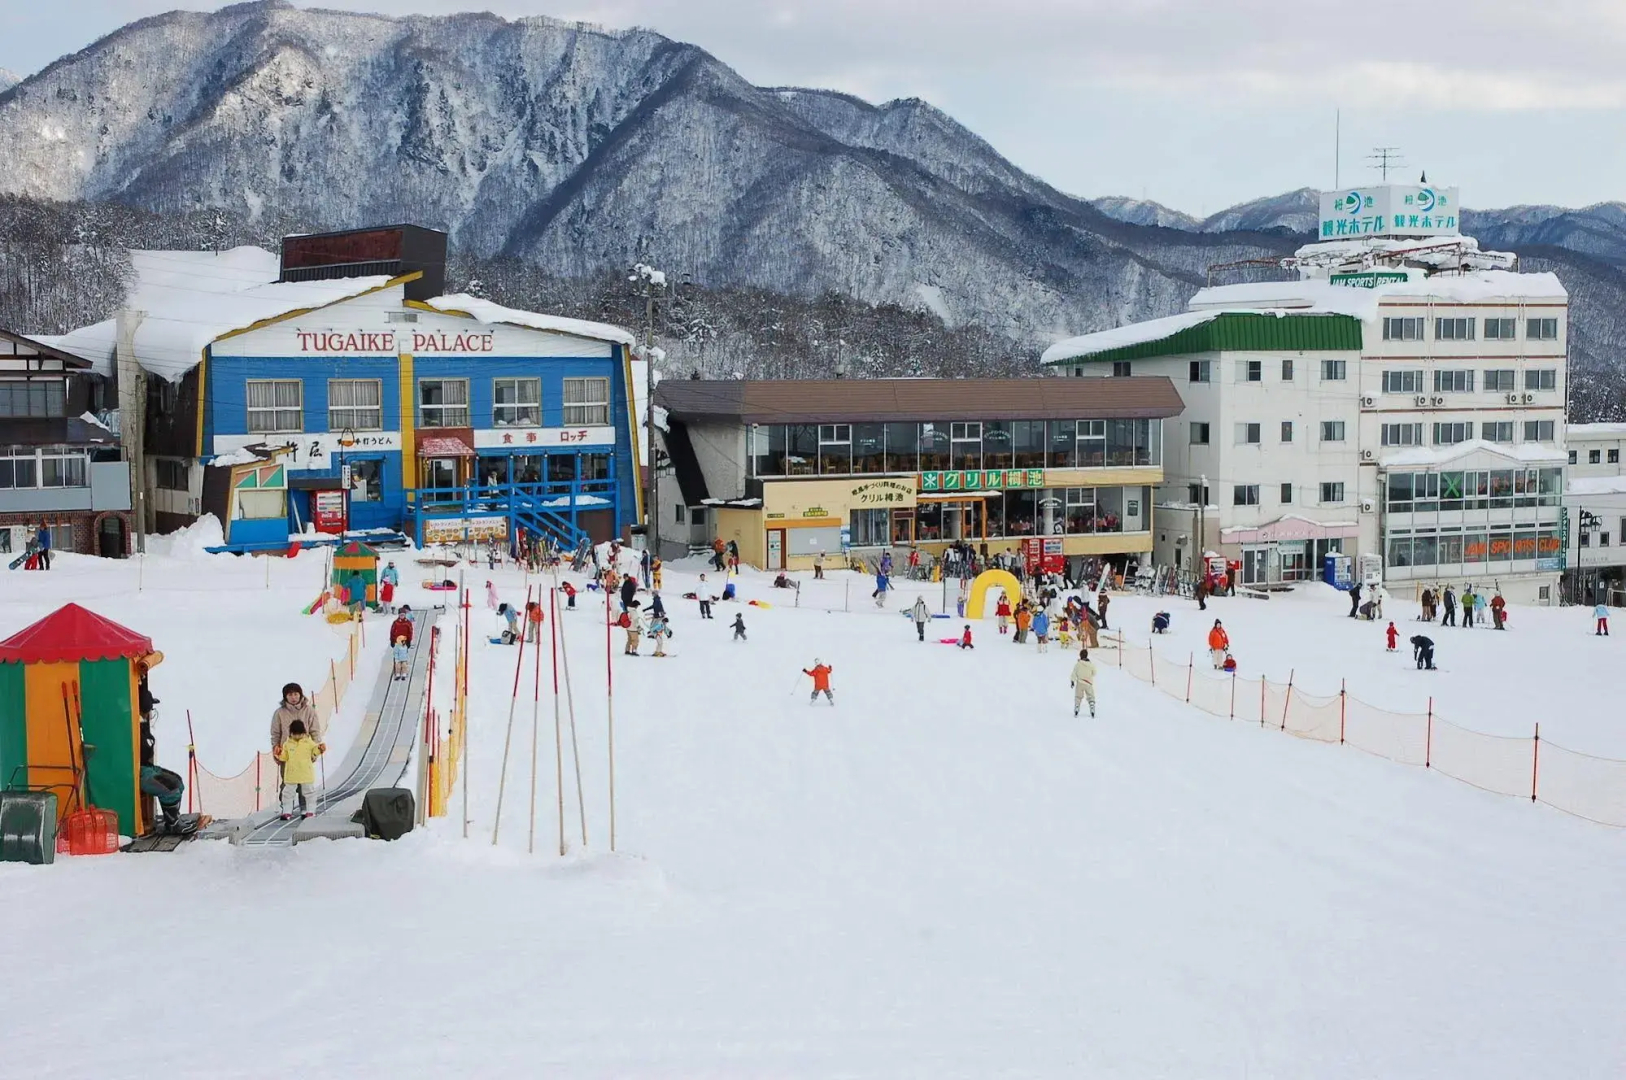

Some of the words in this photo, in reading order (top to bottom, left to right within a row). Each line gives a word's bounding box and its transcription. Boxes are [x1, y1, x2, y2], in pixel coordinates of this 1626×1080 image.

[1363, 196, 1373, 208] 池
[1438, 195, 1447, 206] 池
[1323, 215, 1385, 236] 観光ホテル
[1394, 214, 1456, 229] 観光ホテル
[1347, 277, 1374, 288] SPORTS
[297, 333, 395, 351] TUGAIKE
[413, 334, 493, 352] PALACE
